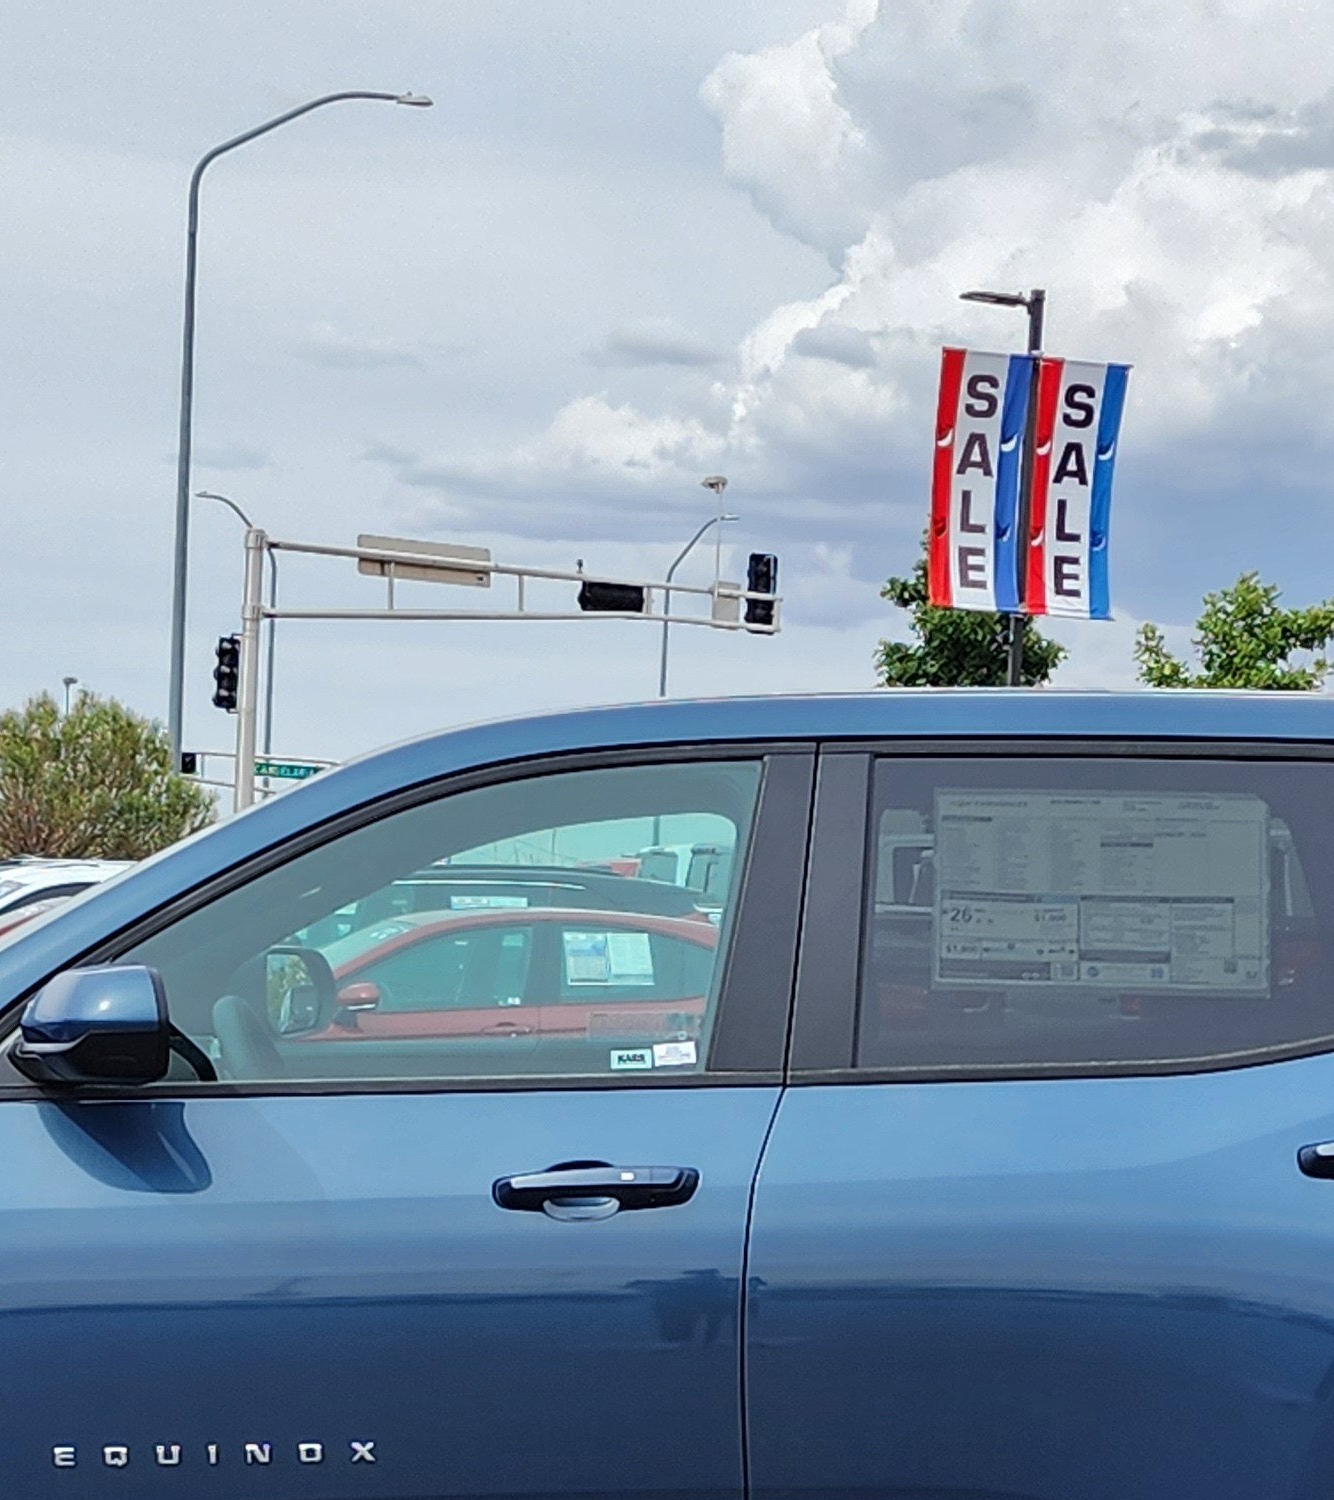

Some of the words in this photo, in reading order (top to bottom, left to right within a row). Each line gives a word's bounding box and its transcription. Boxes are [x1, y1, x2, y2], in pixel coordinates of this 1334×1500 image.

[956, 374, 1000, 590] SALE
[1052, 384, 1096, 598] SALE
[53, 1441, 376, 1467] EQUINOX
